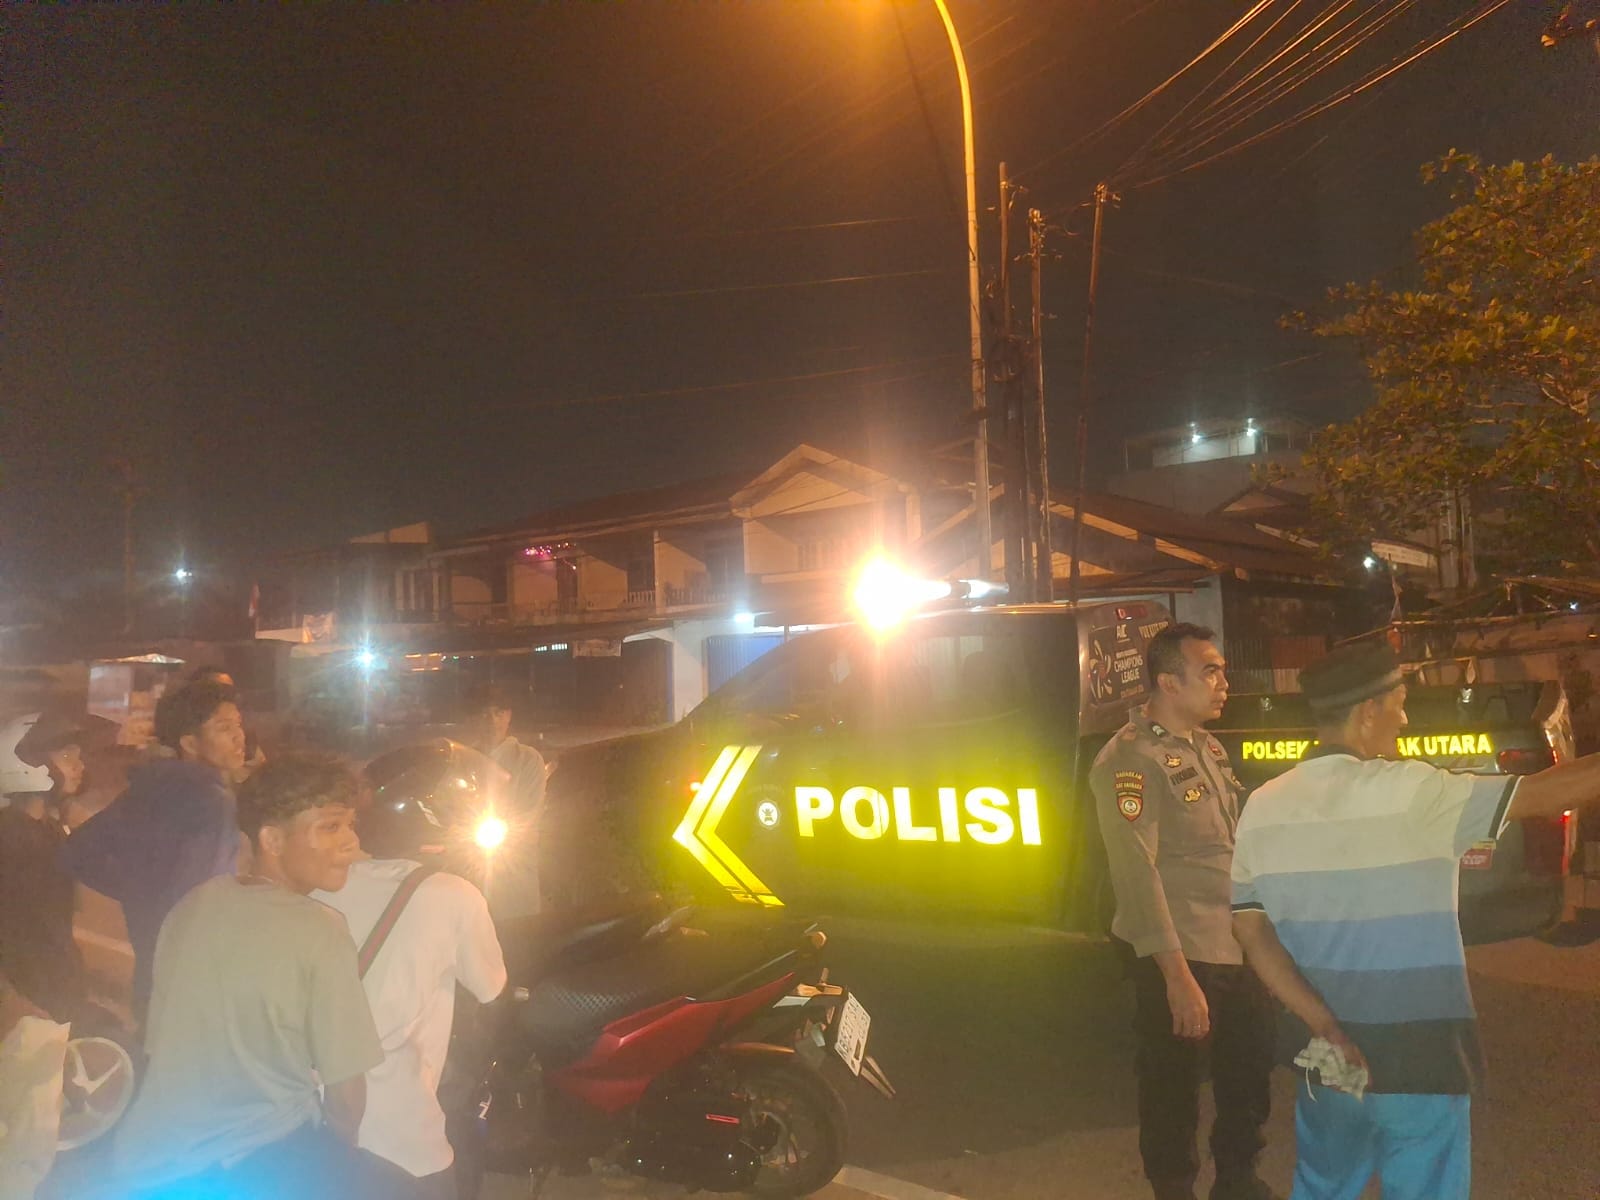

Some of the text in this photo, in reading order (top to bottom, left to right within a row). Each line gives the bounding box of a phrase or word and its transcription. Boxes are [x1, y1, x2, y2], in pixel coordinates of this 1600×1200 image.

[1114, 655, 1143, 672] CHAMPIONS
[1121, 668, 1140, 683] LEAGUE
[1423, 734, 1492, 755] UTARA
[795, 786, 1042, 845] POLISI
